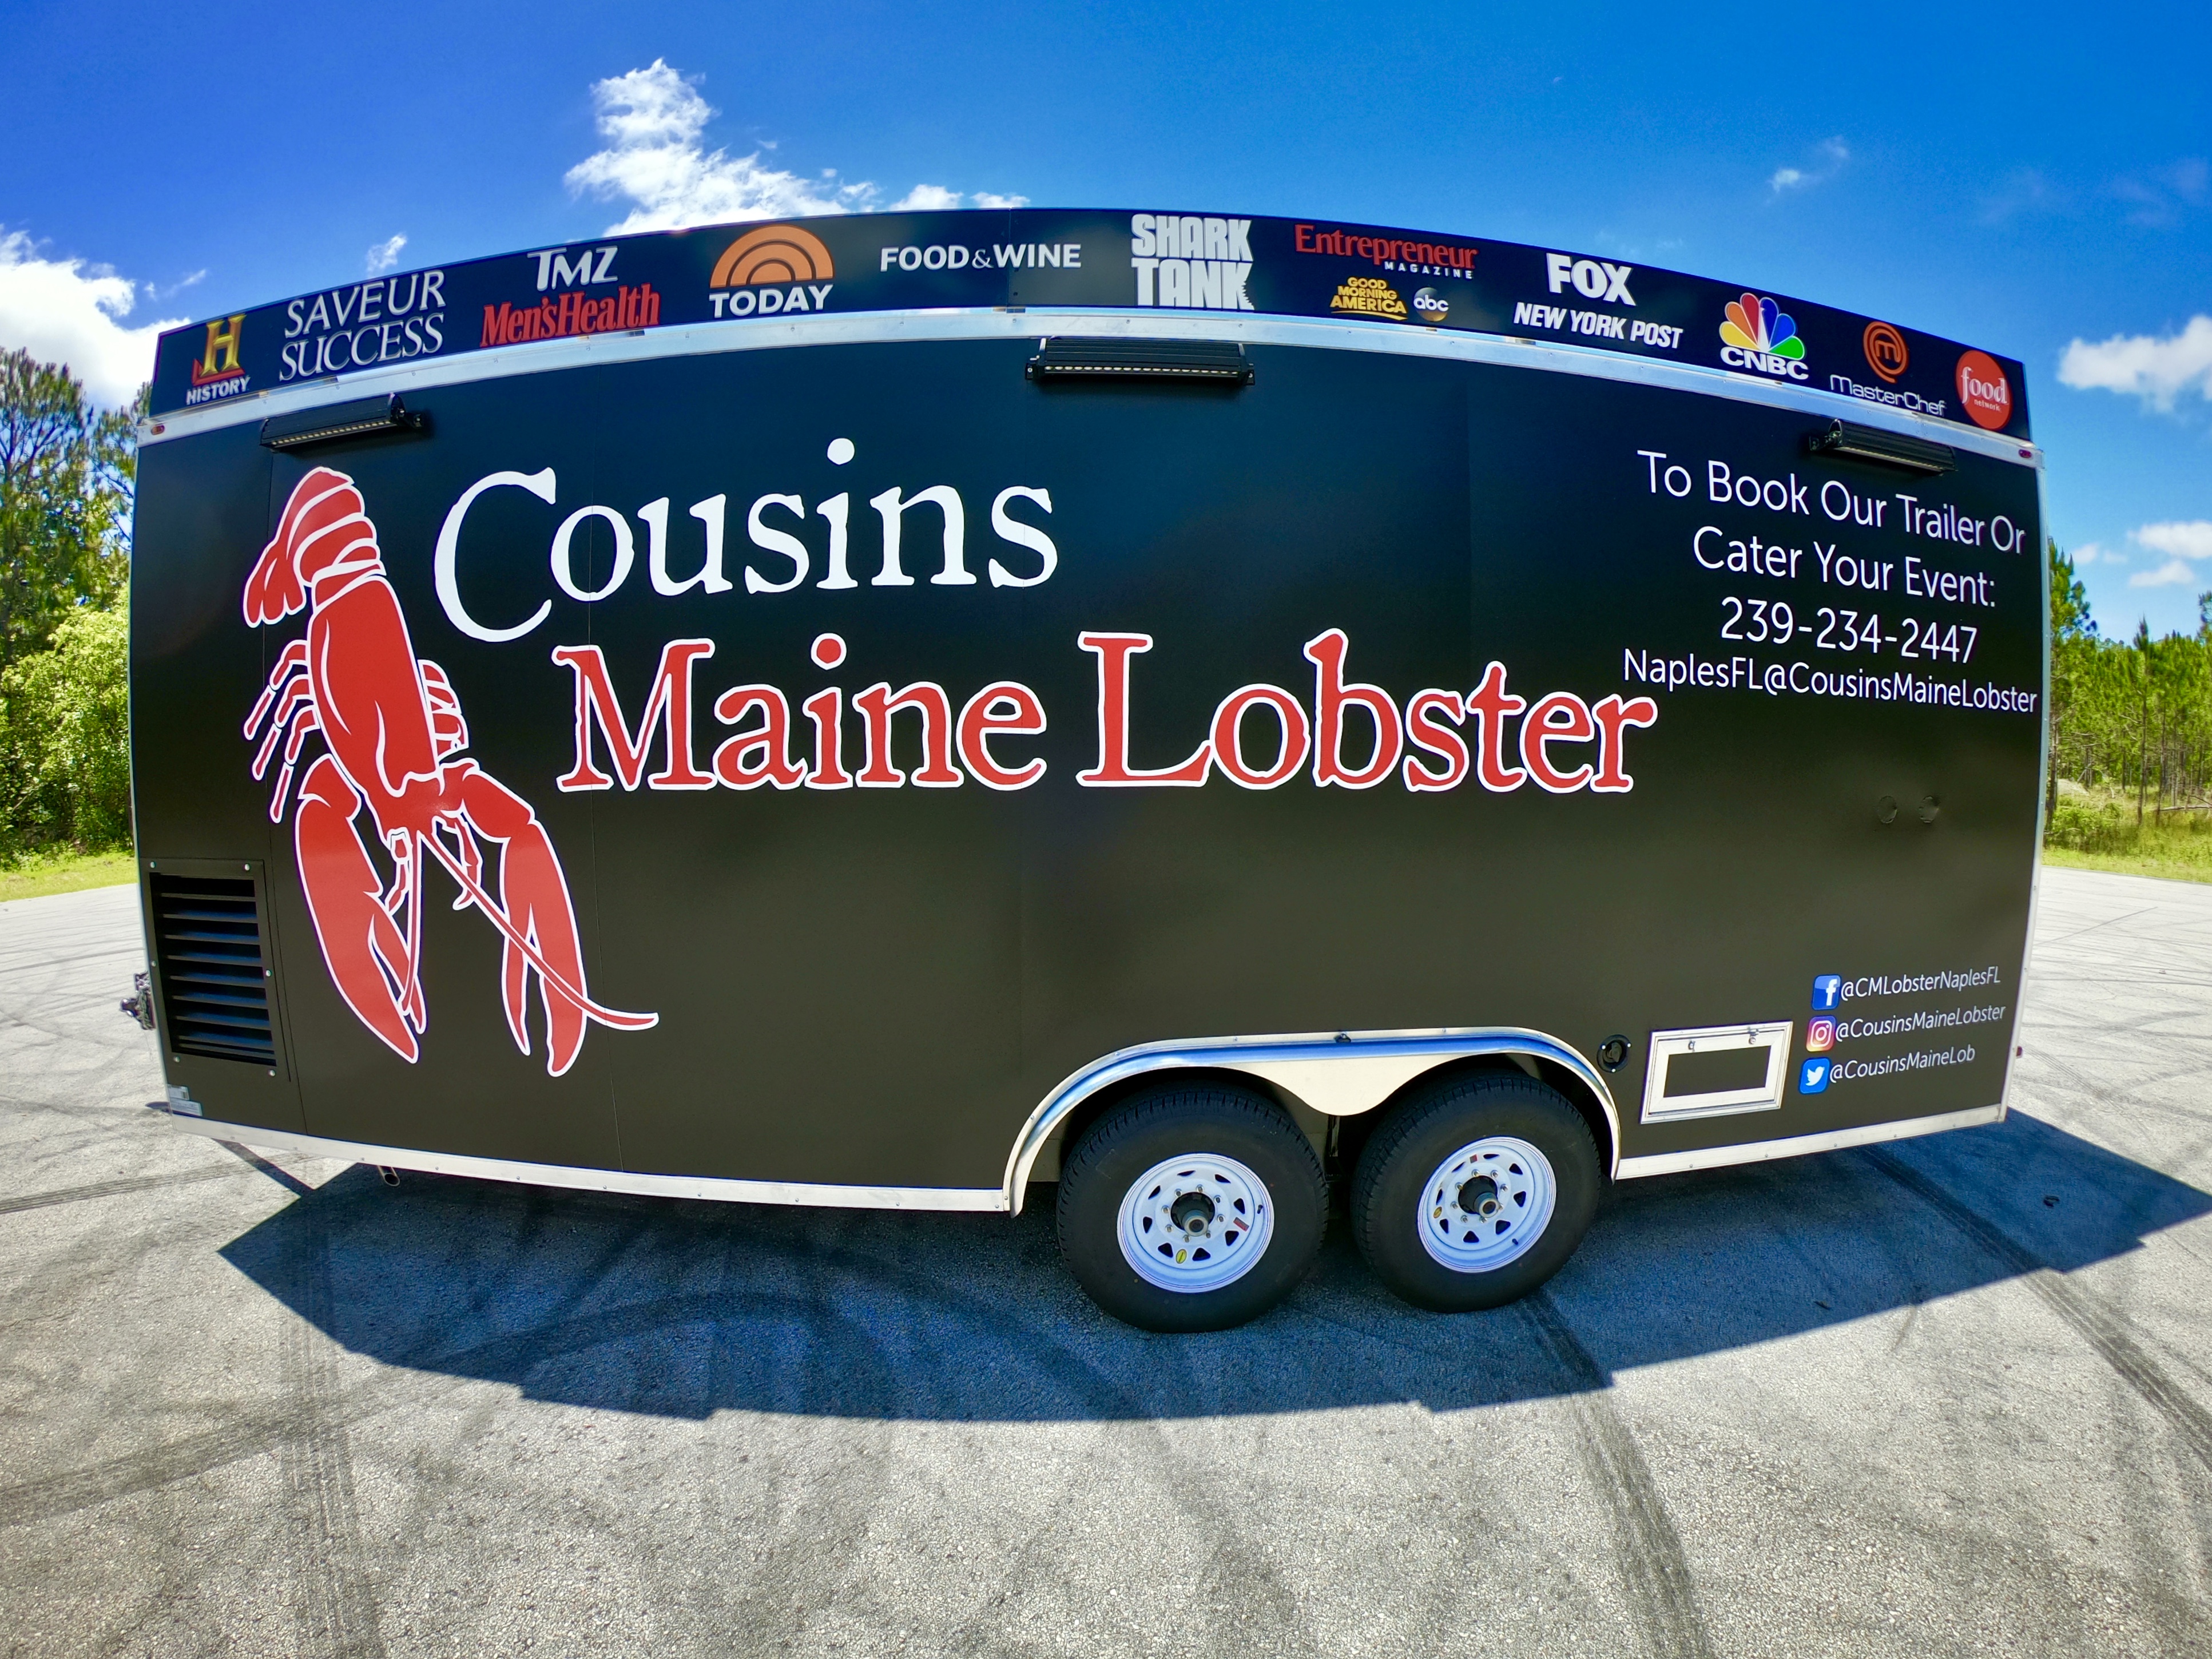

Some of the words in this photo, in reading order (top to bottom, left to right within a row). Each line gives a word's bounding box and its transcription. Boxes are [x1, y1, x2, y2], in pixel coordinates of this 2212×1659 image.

[1131, 214, 1253, 261] SHARK
[1294, 224, 1478, 269] Entrepreneur
[527, 246, 618, 291] TMZ
[1131, 257, 1255, 311] TANK
[1347, 277, 1387, 289] GOOD
[1384, 261, 1474, 280] MAGAZINE
[1546, 252, 1637, 306] FOX
[284, 269, 446, 339] SAVEUR
[709, 284, 833, 317] TODAY
[1329, 295, 1407, 313] AMERICA
[1337, 285, 1397, 300] MORNING
[1413, 295, 1449, 312] abc
[279, 313, 444, 382] SUCCESS
[1514, 301, 1567, 330] NEW
[1570, 309, 1627, 340] YORK
[1630, 320, 1684, 349] POST
[1720, 346, 1809, 380] CNBC
[1960, 366, 2009, 405] food
[186, 375, 251, 405] HISTORY
[1973, 399, 2001, 411] network
[1637, 450, 1691, 497] To
[1708, 460, 1810, 515] Book
[1821, 480, 1887, 527] Our
[1895, 494, 1985, 546] Trailer
[1990, 515, 2026, 554] Or
[433, 437, 1059, 643] Cousins
[1693, 525, 1803, 579] Cater
[1813, 541, 1893, 592] Your
[1904, 557, 1996, 607] Event:
[1721, 596, 1977, 664] 239-234-2447
[1623, 648, 2038, 713] NaplesFL@CousinsMaineLobster
[551, 632, 1048, 792] Maine
[1076, 628, 1659, 794] Lobster
[1840, 966, 2001, 1001] @CMLobsterNaplesFL
[1835, 1006, 2007, 1042] @CousinsMaineLobster
[1829, 1044, 1976, 1083] @CousinsMaineLob
